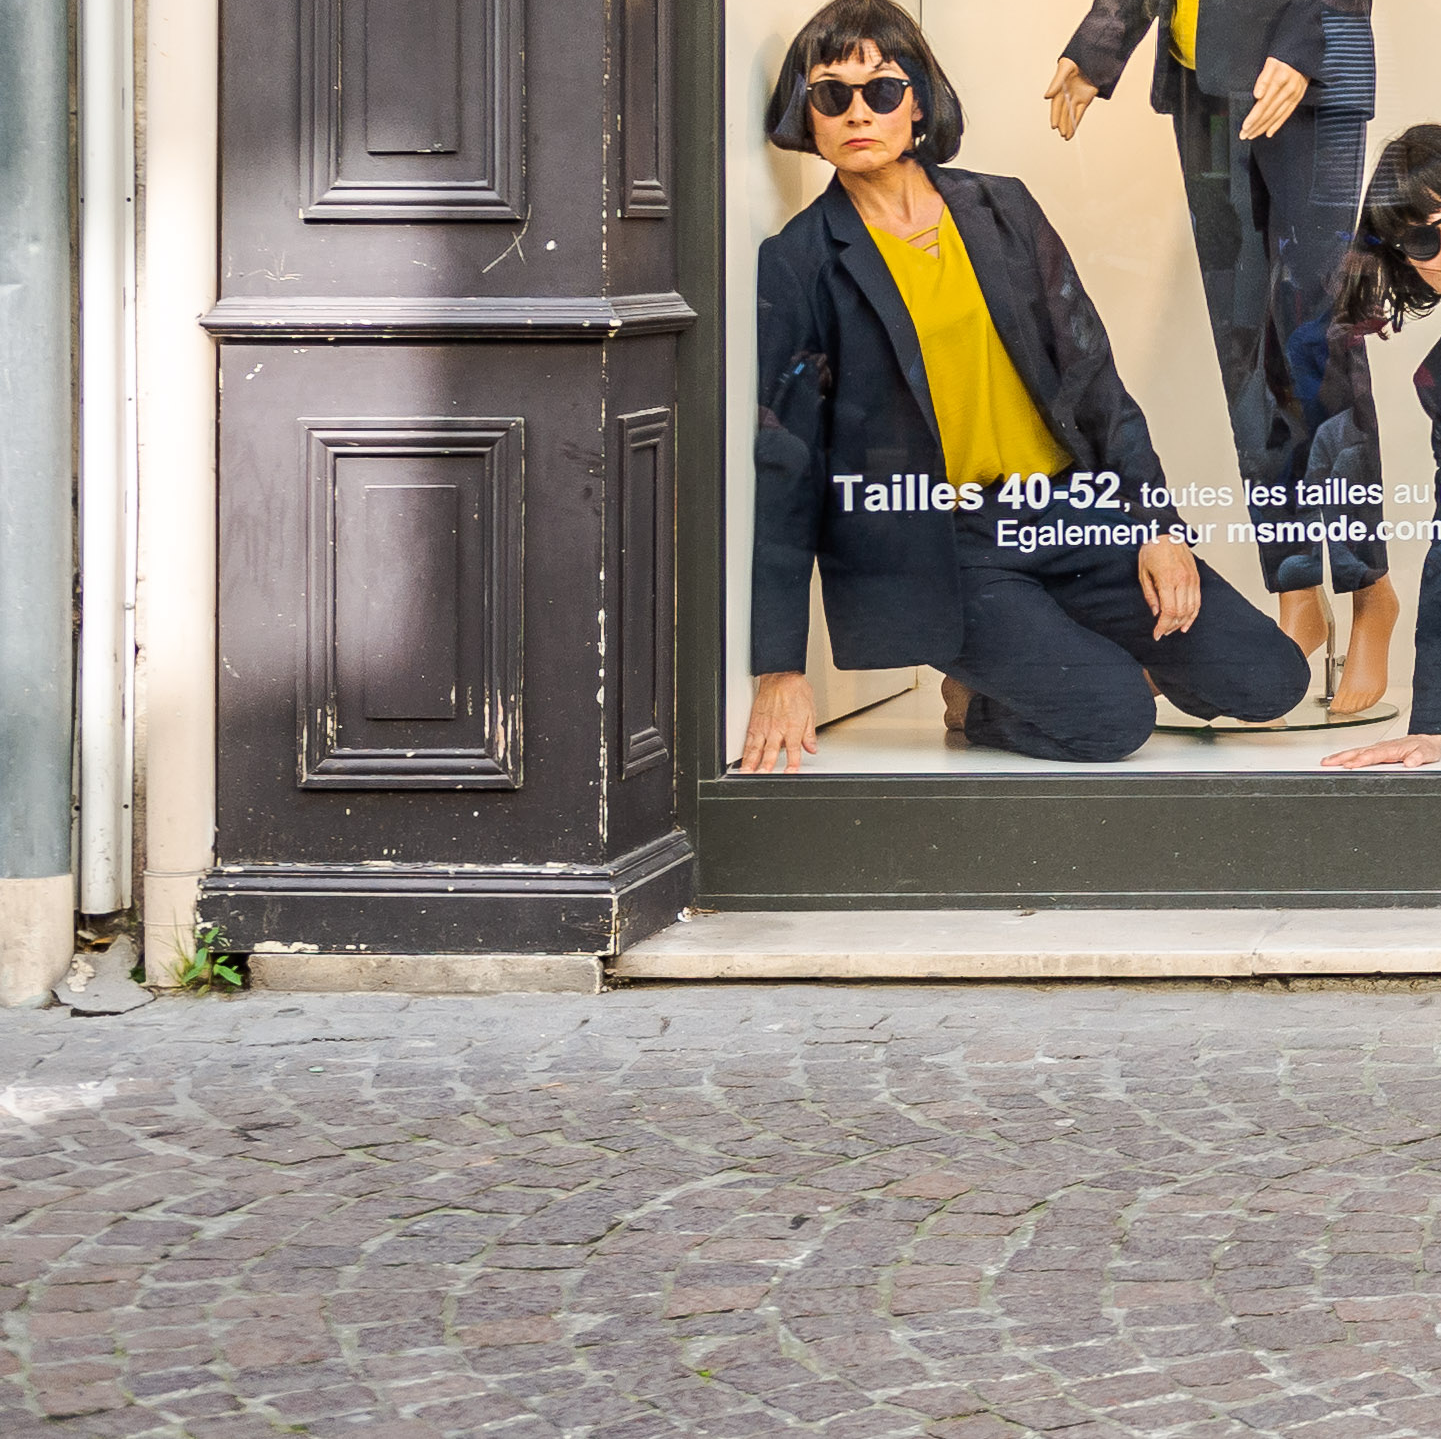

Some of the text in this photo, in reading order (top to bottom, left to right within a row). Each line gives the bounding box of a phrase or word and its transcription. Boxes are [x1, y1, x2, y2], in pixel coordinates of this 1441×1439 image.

[832, 473, 984, 513] Tailles
[997, 470, 1132, 513] 40-52,
[1140, 481, 1234, 509] toutes
[1243, 478, 1288, 507] les
[1295, 477, 1384, 505] tailles
[1393, 482, 1430, 504] au
[996, 518, 1161, 554] Egalement
[1168, 522, 1217, 546] sur
